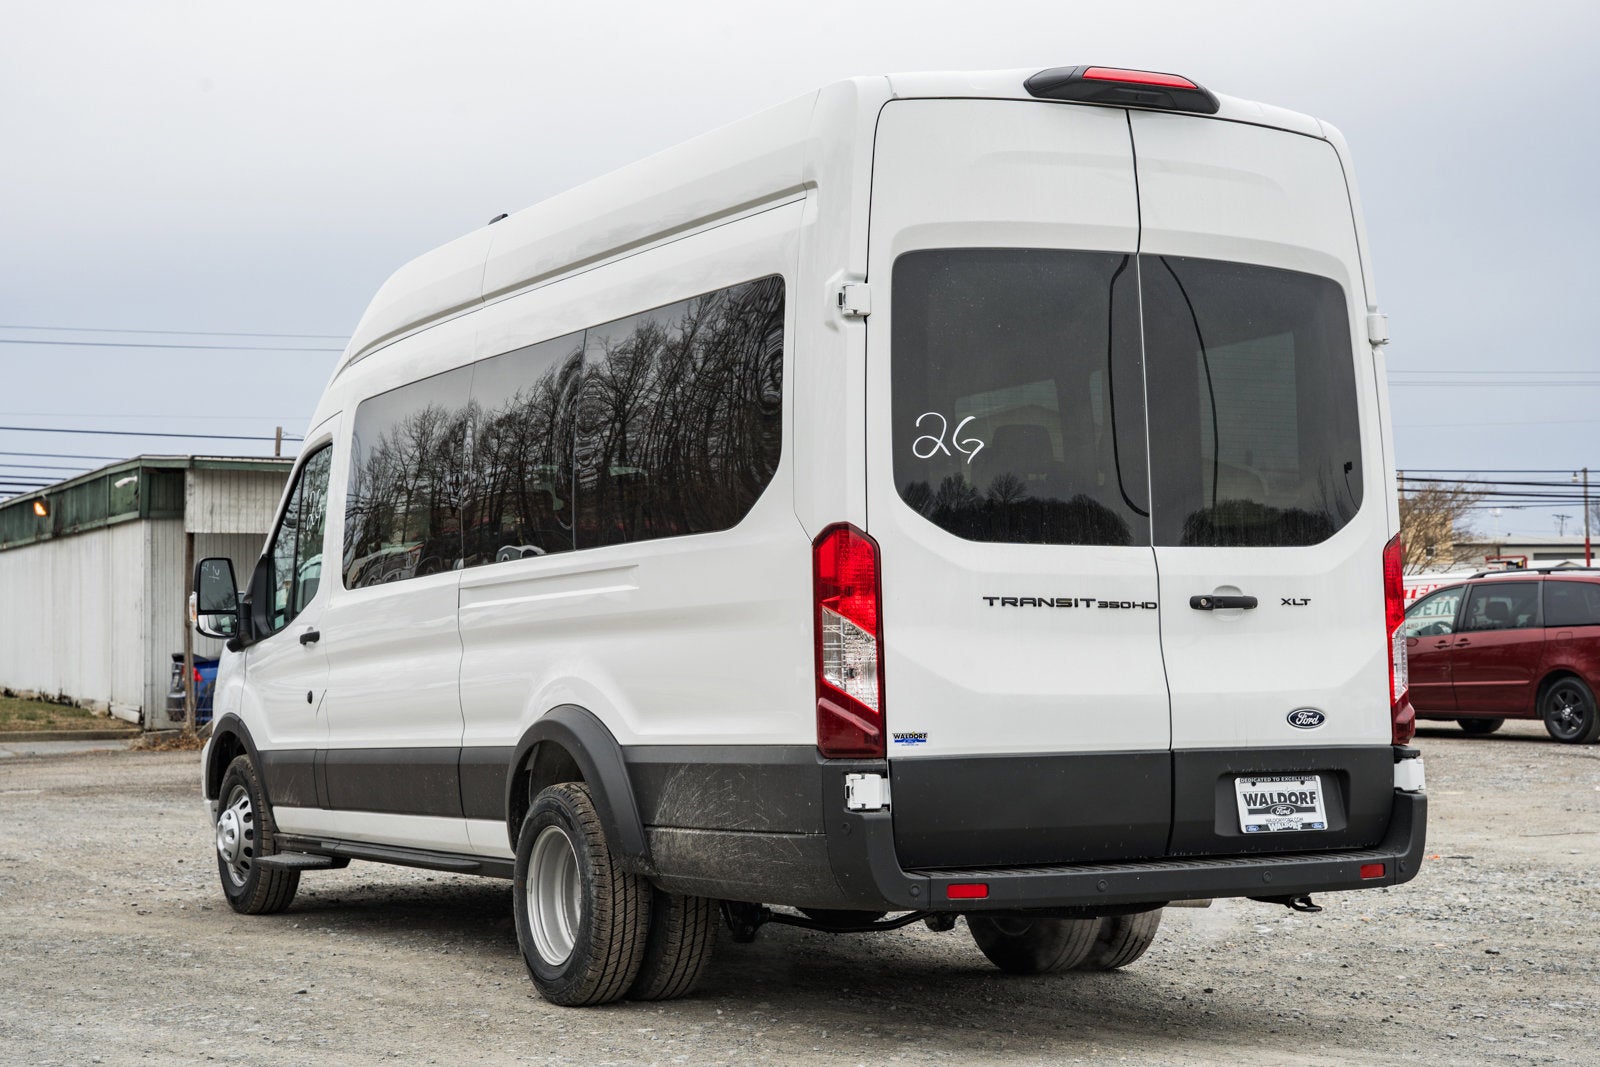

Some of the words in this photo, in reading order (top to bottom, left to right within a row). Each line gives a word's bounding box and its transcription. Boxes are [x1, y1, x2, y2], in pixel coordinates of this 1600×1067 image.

[983, 597, 1096, 608] TRANSIT
[1097, 601, 1158, 609] 350HD
[1281, 598, 1311, 606] XLT
[1296, 712, 1319, 725] Ford
[1243, 791, 1316, 807] WALDORF
[1275, 806, 1291, 815] Ford
[1268, 822, 1302, 832] WALDORF
